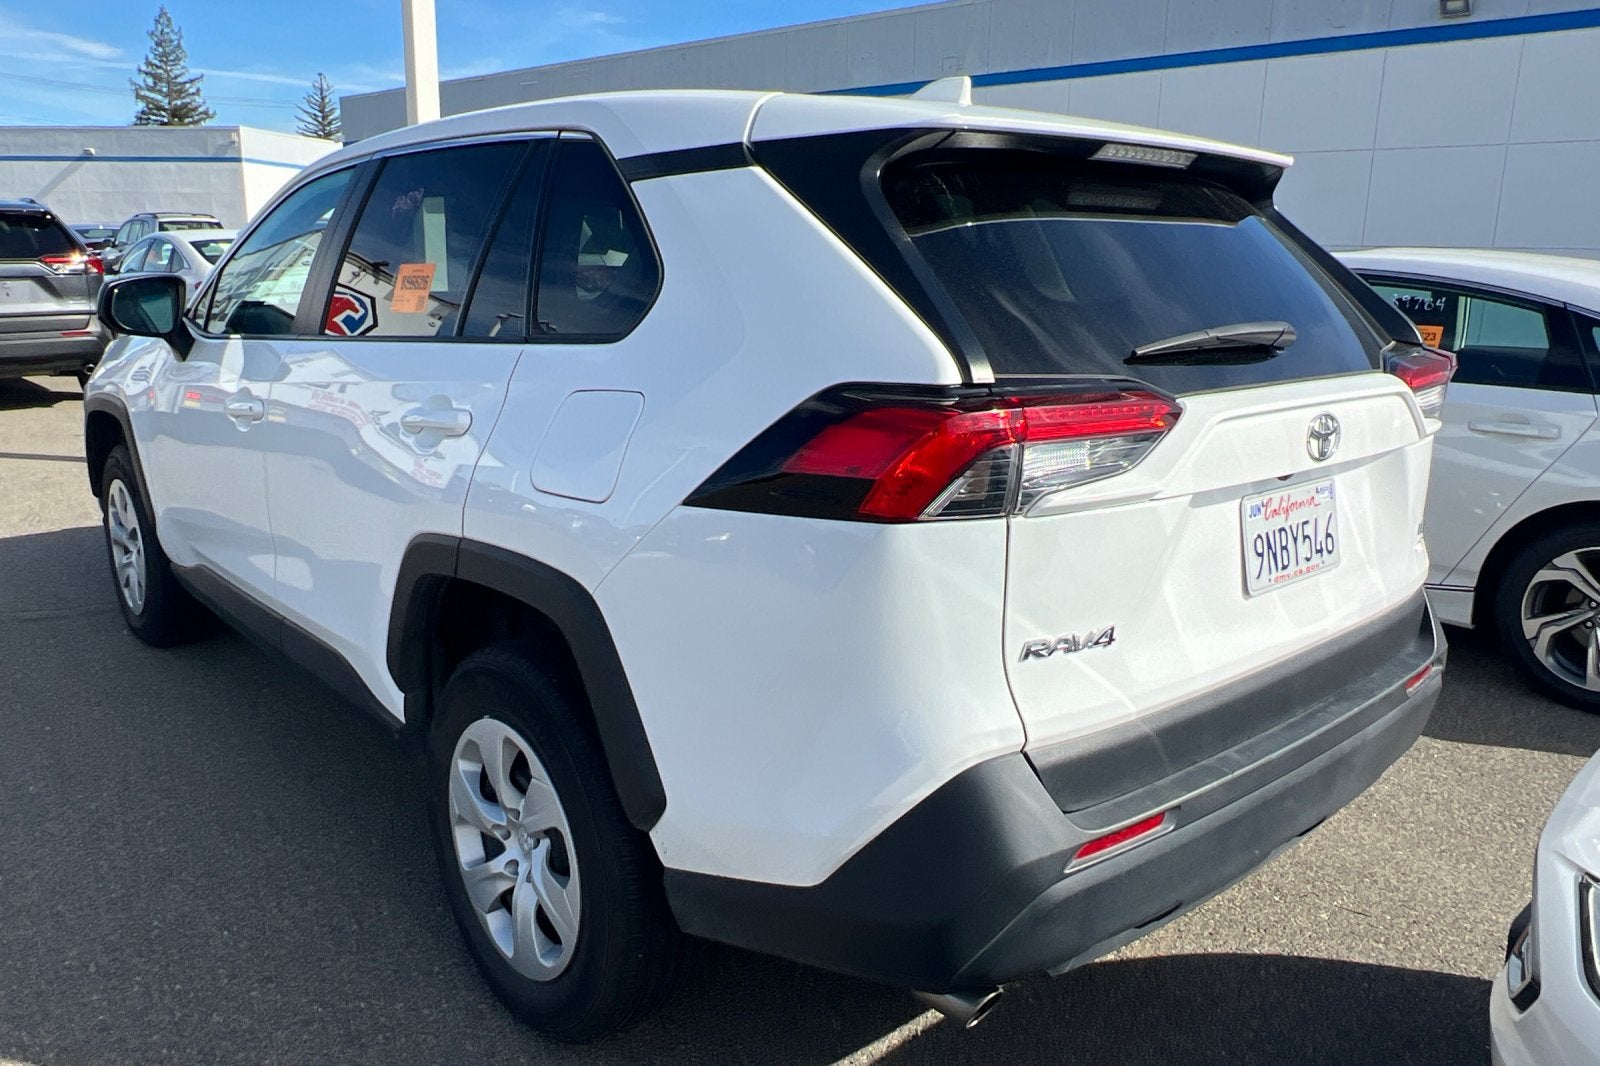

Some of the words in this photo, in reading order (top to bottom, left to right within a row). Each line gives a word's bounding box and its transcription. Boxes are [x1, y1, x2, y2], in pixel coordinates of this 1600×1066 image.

[1249, 504, 1262, 519] JUN
[1264, 494, 1320, 521] California
[1254, 513, 1334, 580] 9NBY546
[1274, 563, 1320, 583] dmv.ca.gov
[1018, 624, 1116, 663] RAV4
